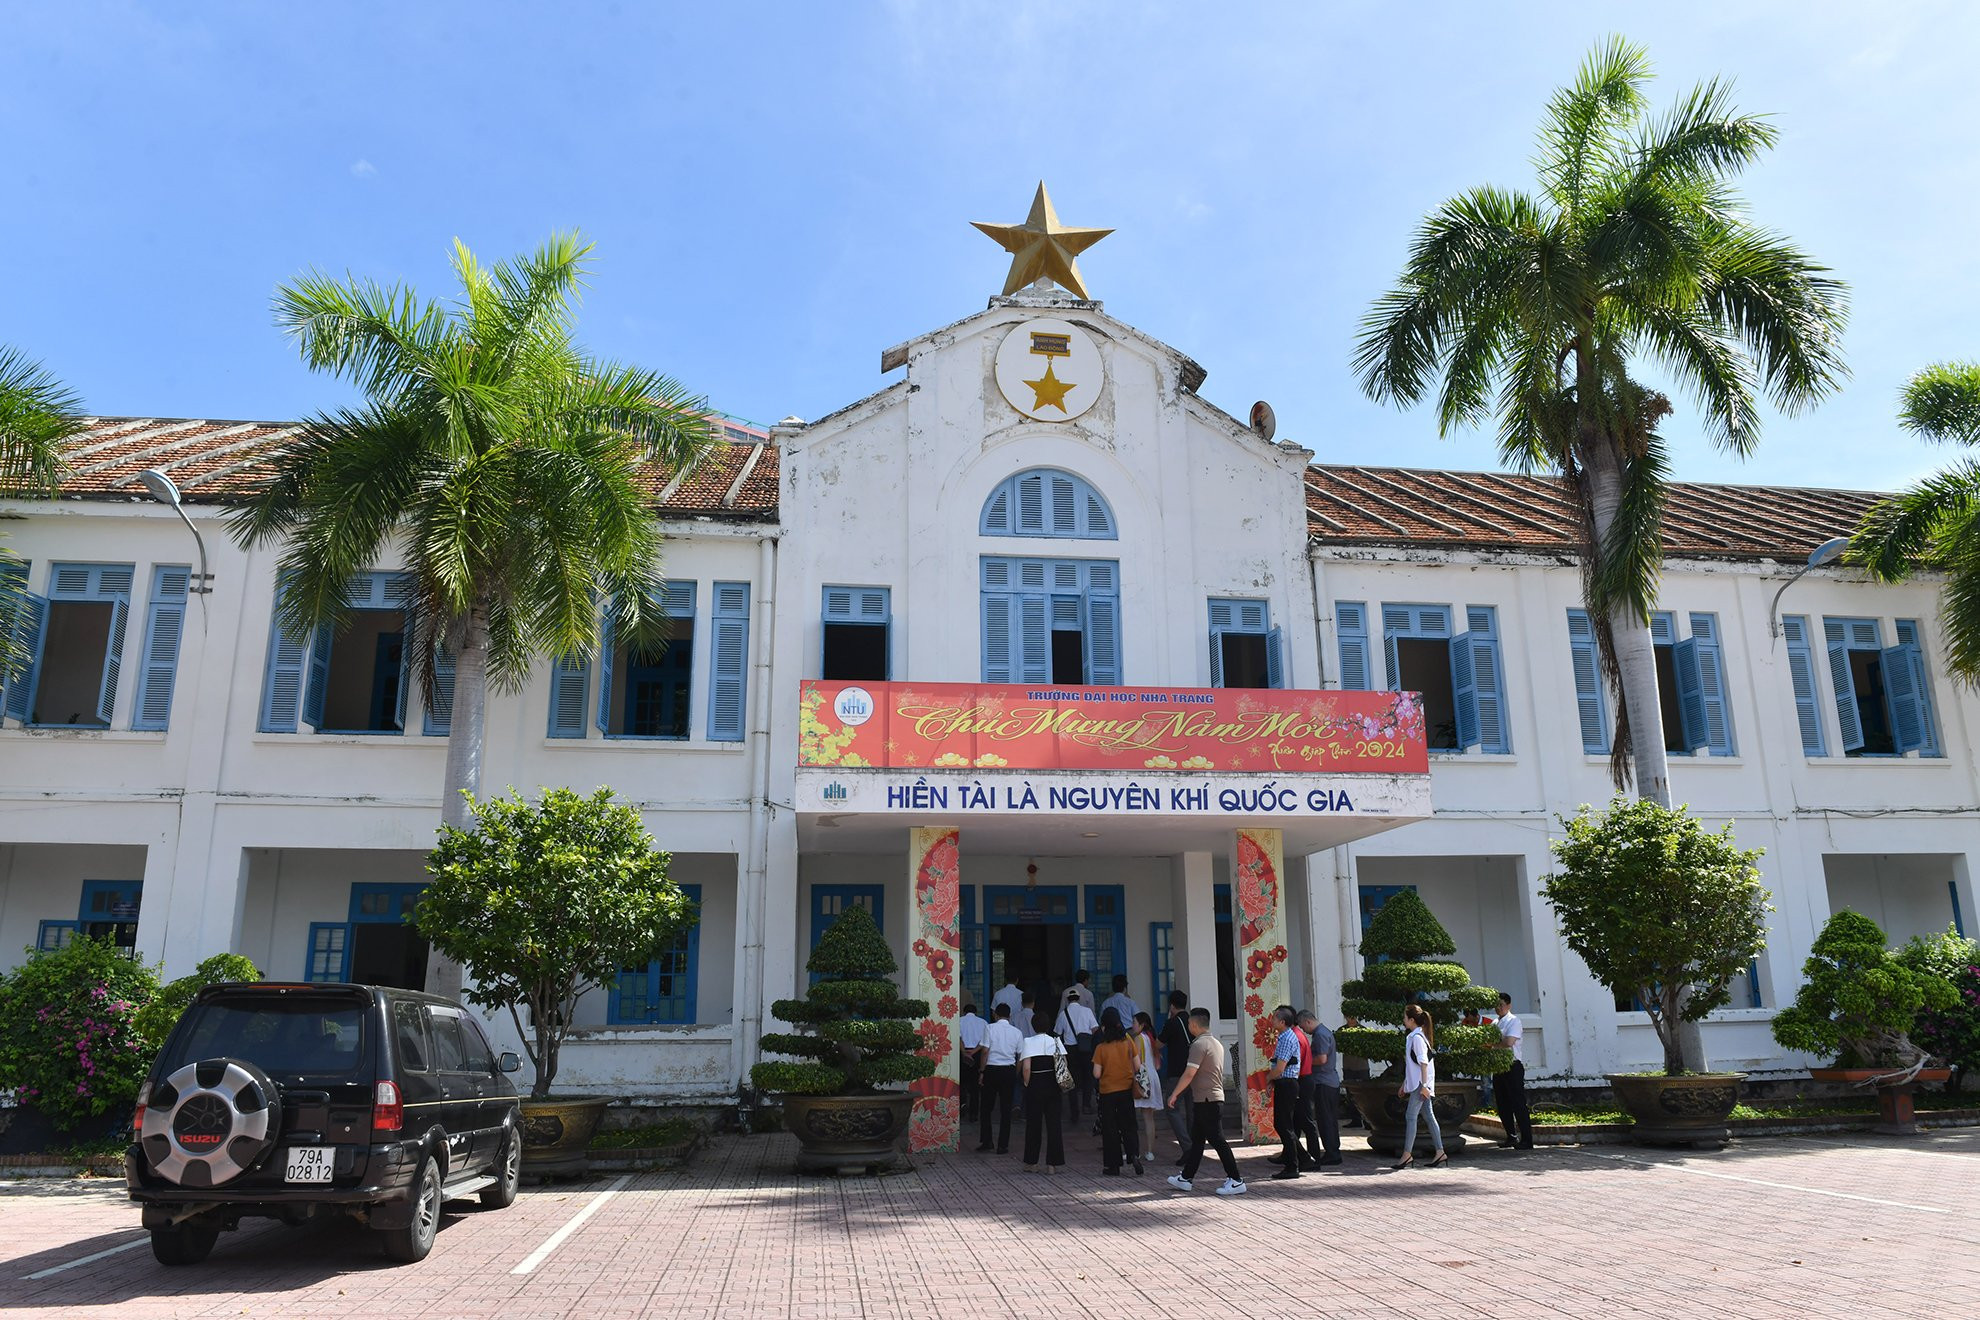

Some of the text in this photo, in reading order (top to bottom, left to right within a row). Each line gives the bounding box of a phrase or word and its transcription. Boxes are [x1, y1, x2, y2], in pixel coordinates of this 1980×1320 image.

[1084, 692, 1106, 704] ĐẠI
[1110, 692, 1137, 704] HỌC
[1140, 693, 1168, 703] NHA
[1172, 694, 1214, 704] TRANG
[843, 706, 865, 715] NTU
[896, 705, 1022, 741] Chúc
[990, 707, 1145, 747] Mừng
[1219, 711, 1337, 744] Mới
[1355, 741, 1406, 758] 2024
[887, 775, 1355, 812] HIỀN TÀI LÀ NGUYÊN KHÍ QUỐC GIA
[179, 1134, 221, 1144] ISUZU
[298, 1149, 323, 1165] 79A
[286, 1165, 332, 1181] 028.12
